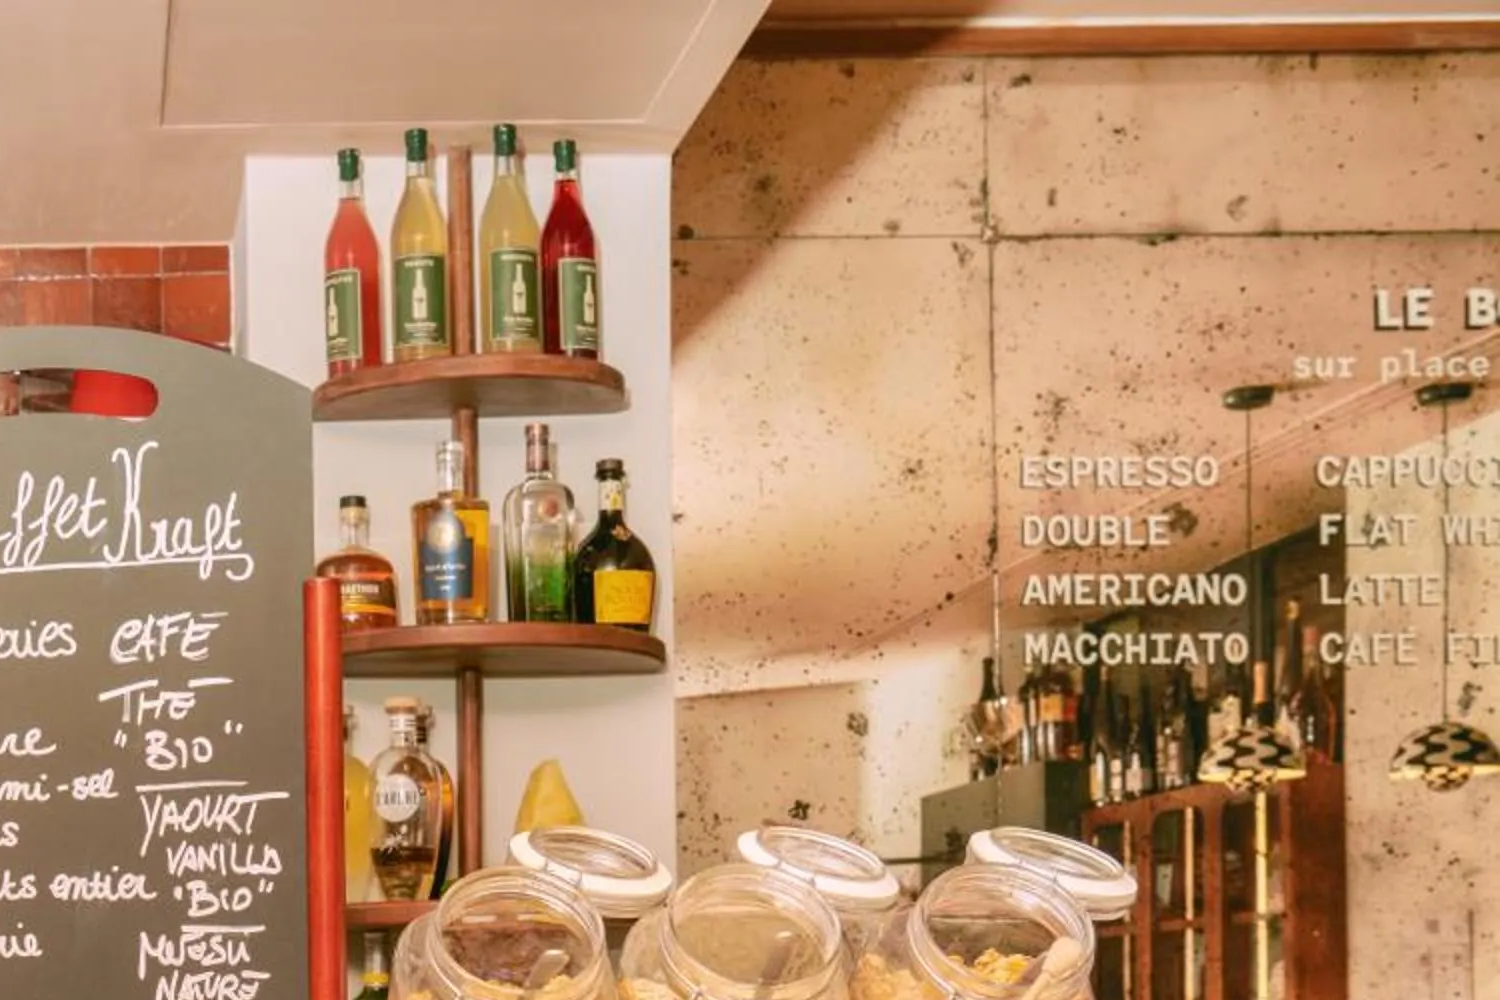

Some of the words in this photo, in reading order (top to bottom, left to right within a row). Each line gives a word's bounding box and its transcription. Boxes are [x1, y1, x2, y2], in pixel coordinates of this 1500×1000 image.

[1374, 286, 1435, 331] LE
[1464, 286, 1500, 331] B
[1293, 355, 1358, 379] sur
[1379, 348, 1491, 384] place
[1020, 456, 1220, 489] ESPRESSO
[103, 441, 245, 580] Kraft
[1022, 514, 1172, 547] DOUBLE
[1318, 513, 1417, 547] FLAT
[1022, 573, 1248, 607] AMERICANO
[1319, 573, 1441, 607] LATTE
[1023, 632, 1251, 666] MACCHIATO
[139, 791, 291, 858] YAOURT
[49, 865, 158, 901] entier
